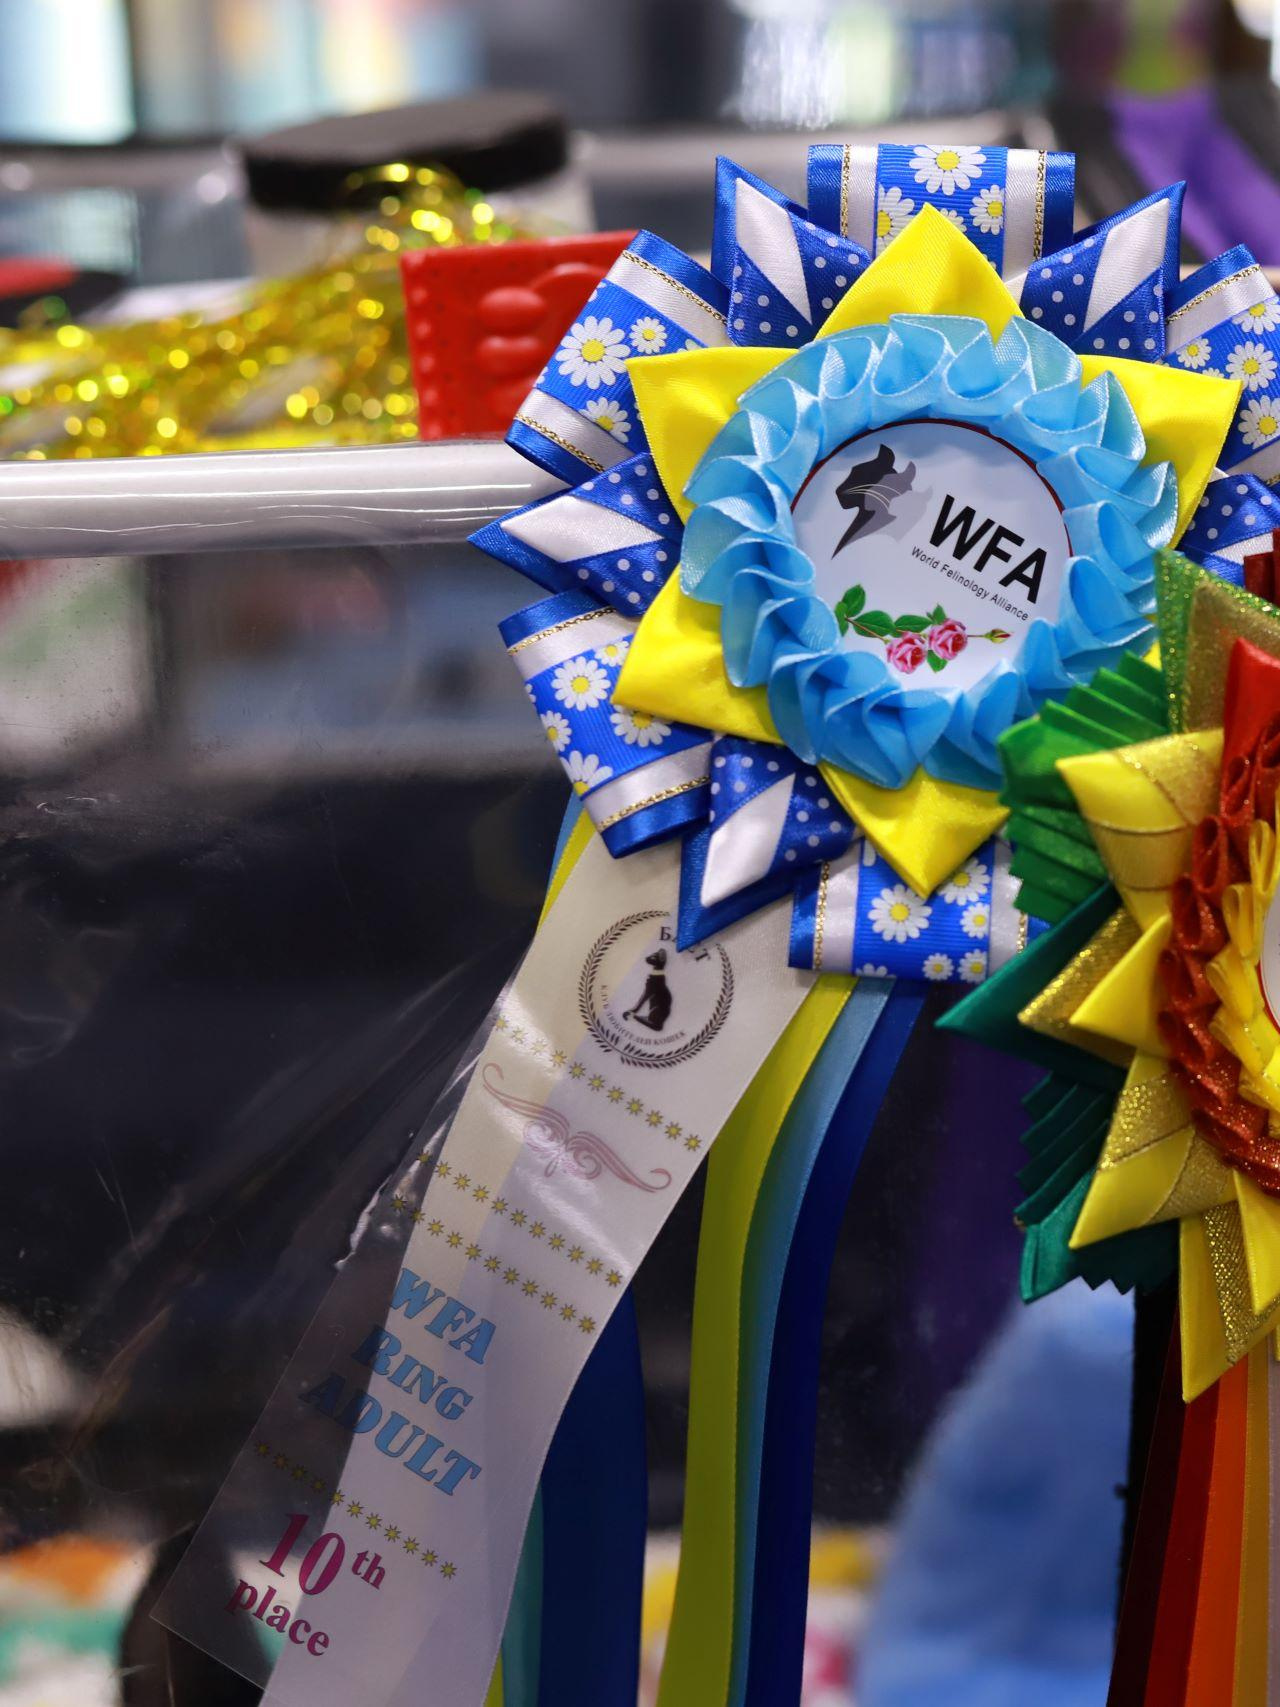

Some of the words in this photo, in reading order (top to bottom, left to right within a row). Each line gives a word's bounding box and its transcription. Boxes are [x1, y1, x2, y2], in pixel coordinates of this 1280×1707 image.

[911, 546, 940, 569] World
[940, 564, 990, 599] Felinology
[990, 593, 1029, 621] Alliance
[930, 494, 1047, 604] WFA
[659, 926, 712, 962] БТ
[391, 1267, 497, 1365] WFA
[352, 1324, 475, 1420] RING
[298, 1373, 482, 1496] ADULT
[224, 1578, 331, 1657] place
